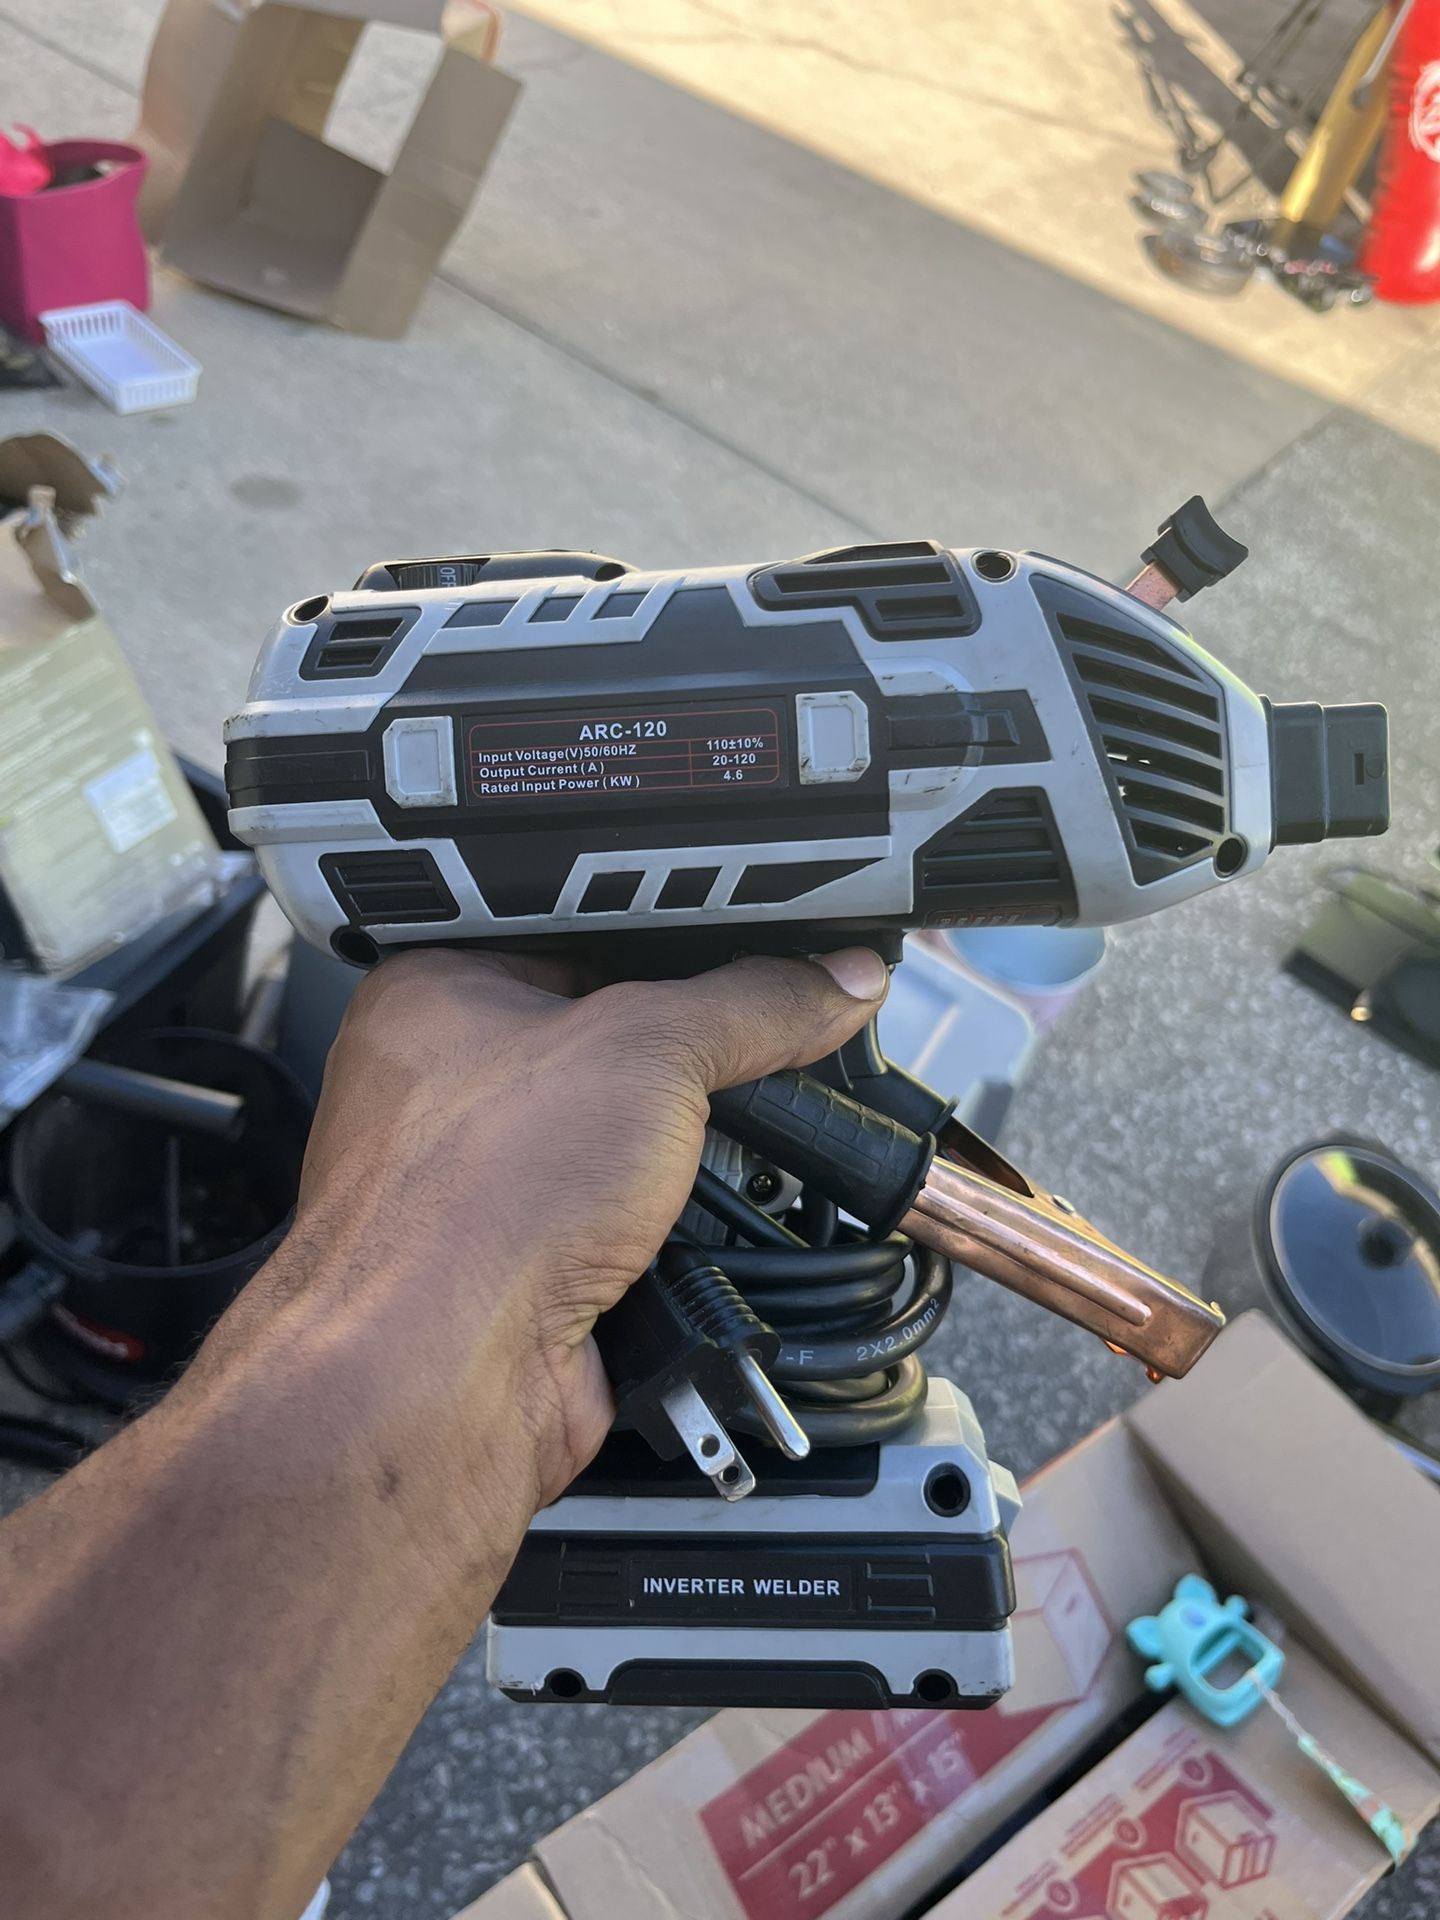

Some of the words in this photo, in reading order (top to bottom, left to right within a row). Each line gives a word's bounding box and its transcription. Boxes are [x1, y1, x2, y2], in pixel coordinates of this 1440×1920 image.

[579, 720, 668, 741] ARC-120
[706, 737, 764, 751] 110±10%
[478, 752, 513, 764] Input
[712, 753, 756, 766] 20-120
[479, 767, 525, 780] Output
[527, 763, 578, 776] Current
[723, 769, 743, 781] 4.6
[480, 782, 519, 795] Rated
[522, 780, 556, 793] Input
[559, 778, 600, 791] Power
[781, 1349, 814, 1365] -F
[643, 1577, 745, 1594] INVERTER
[753, 1579, 840, 1596] WELDER
[739, 1728, 873, 1850] MEDIUM
